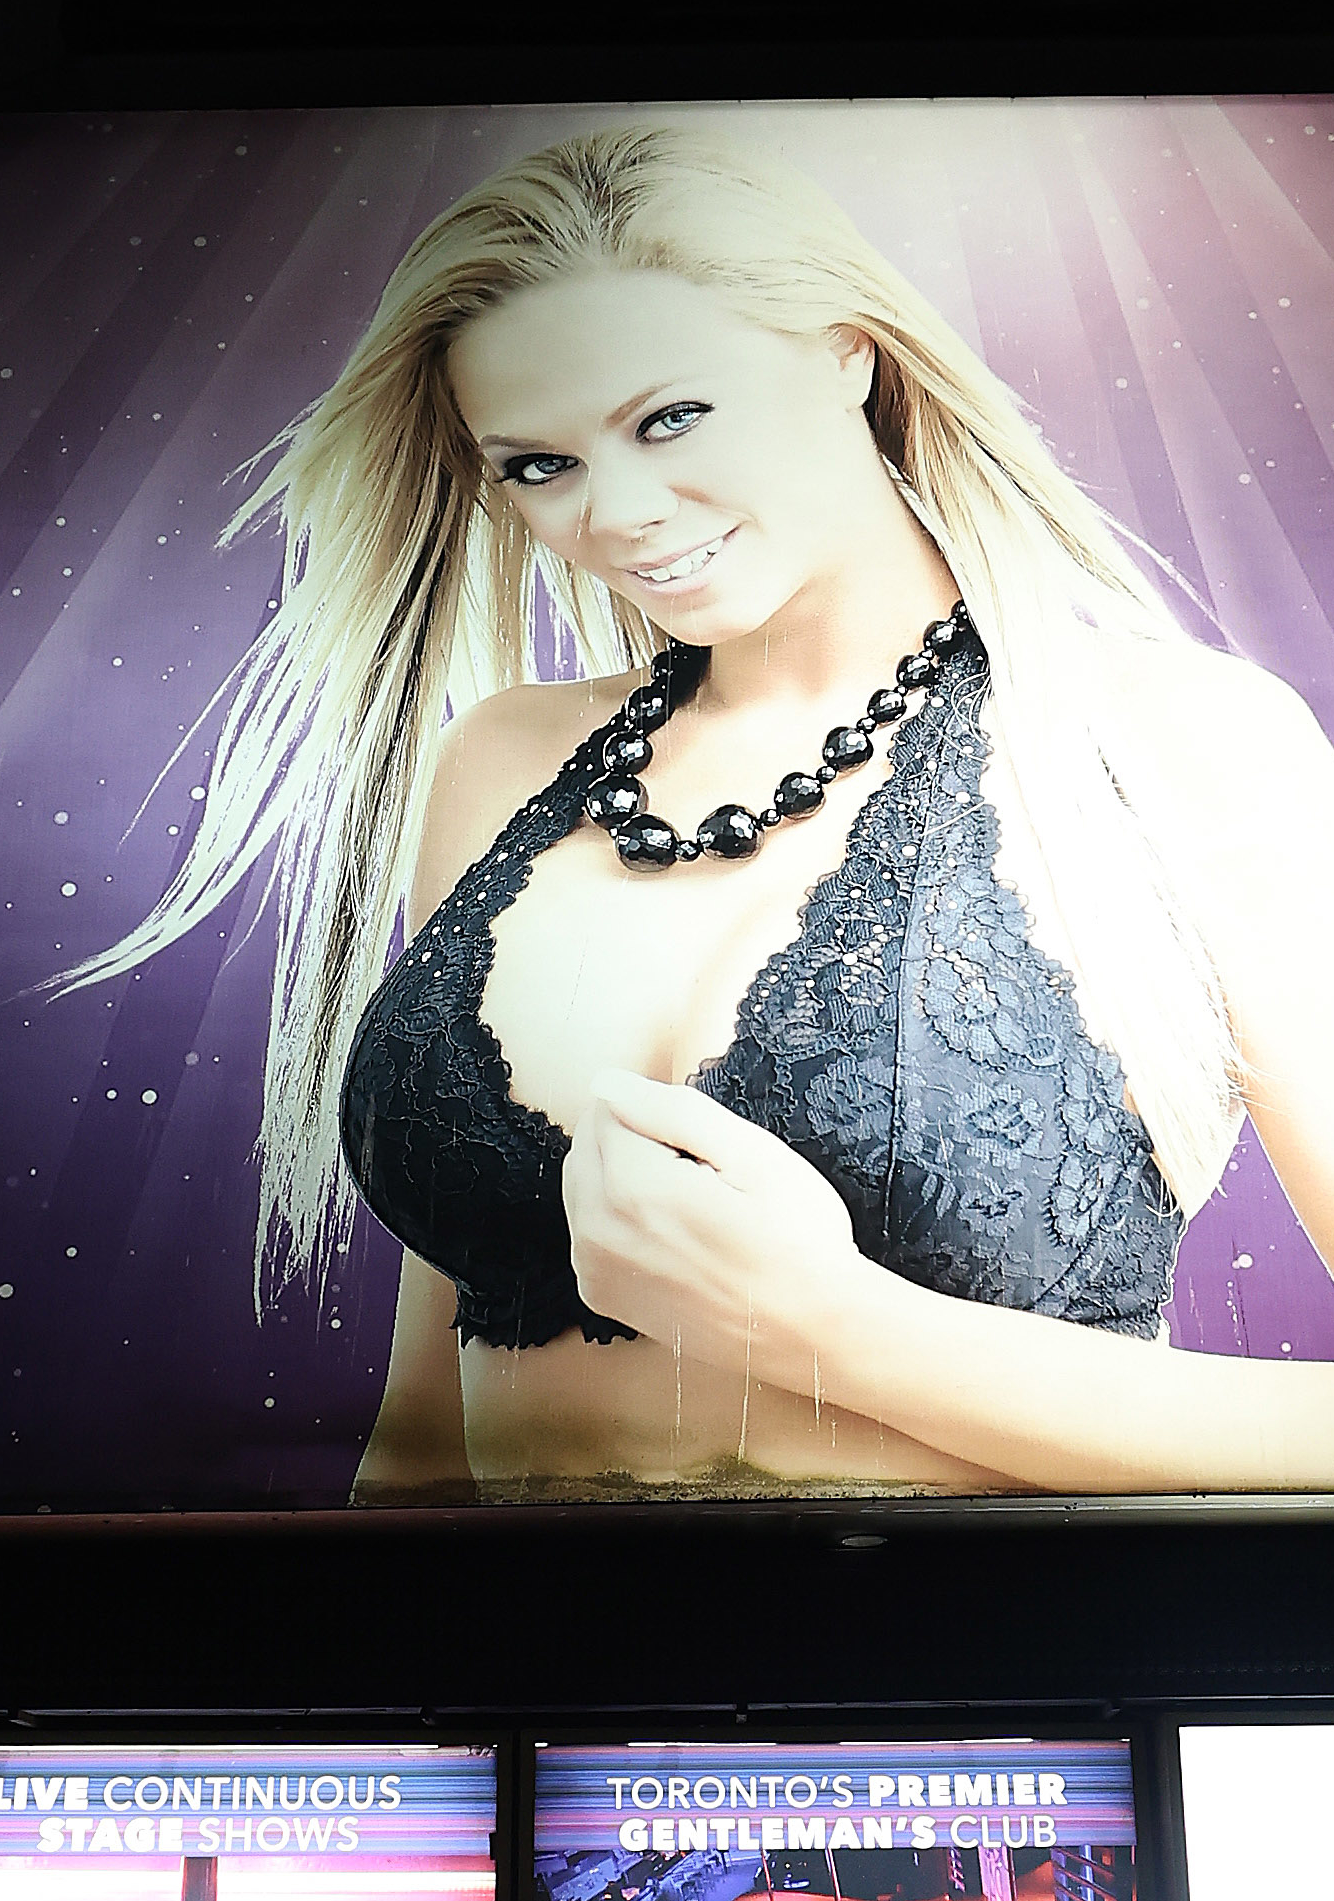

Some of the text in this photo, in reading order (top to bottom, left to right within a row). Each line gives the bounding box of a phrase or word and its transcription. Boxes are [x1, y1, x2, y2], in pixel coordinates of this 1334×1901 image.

[102, 1775, 401, 1811] CONTINUOUS
[607, 1773, 1067, 1810] TORONTO'S PREMIER
[37, 1817, 359, 1853] STAGE SHOWS
[619, 1815, 1057, 1851] GENTLEMAN'S CLUB
